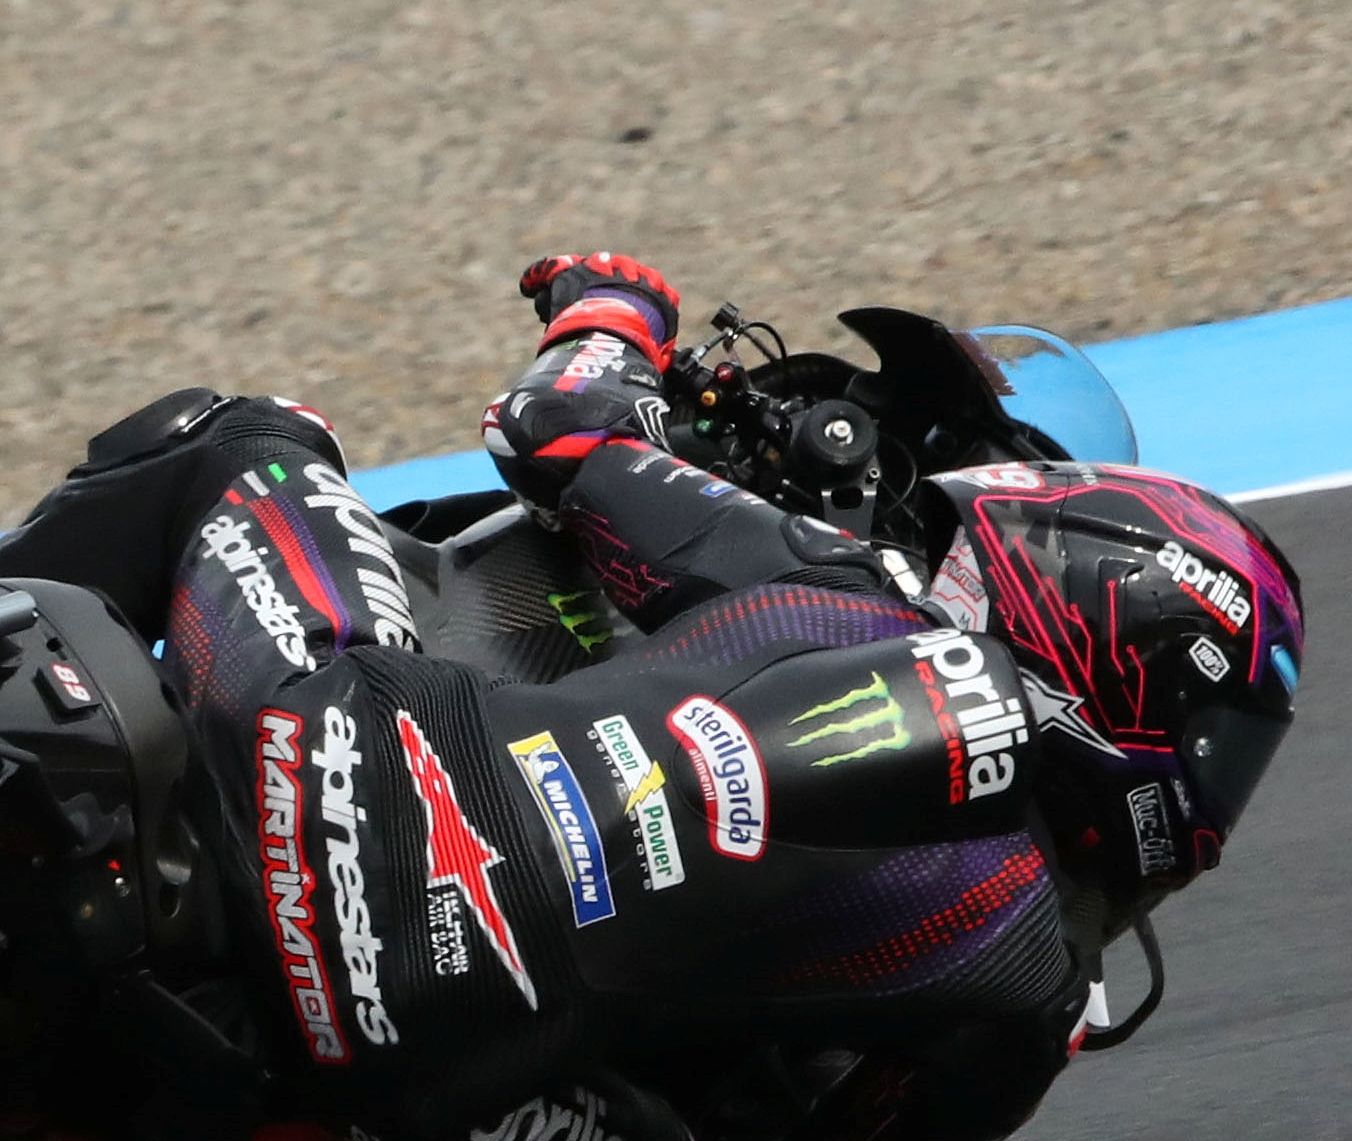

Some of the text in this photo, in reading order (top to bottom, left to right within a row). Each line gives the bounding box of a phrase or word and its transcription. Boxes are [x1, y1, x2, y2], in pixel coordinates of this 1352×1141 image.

[201, 515, 316, 671] alpinestars
[1156, 541, 1251, 628] aprilia
[1197, 645, 1223, 674] 100%
[684, 705, 761, 844] sterilgarda
[906, 628, 1029, 800] aprilia
[914, 660, 964, 805] RACING
[544, 779, 598, 902] MICHELIN
[602, 720, 673, 876] Green Power
[262, 714, 344, 1058] MARTINATOR
[312, 706, 398, 1044] alpinestars
